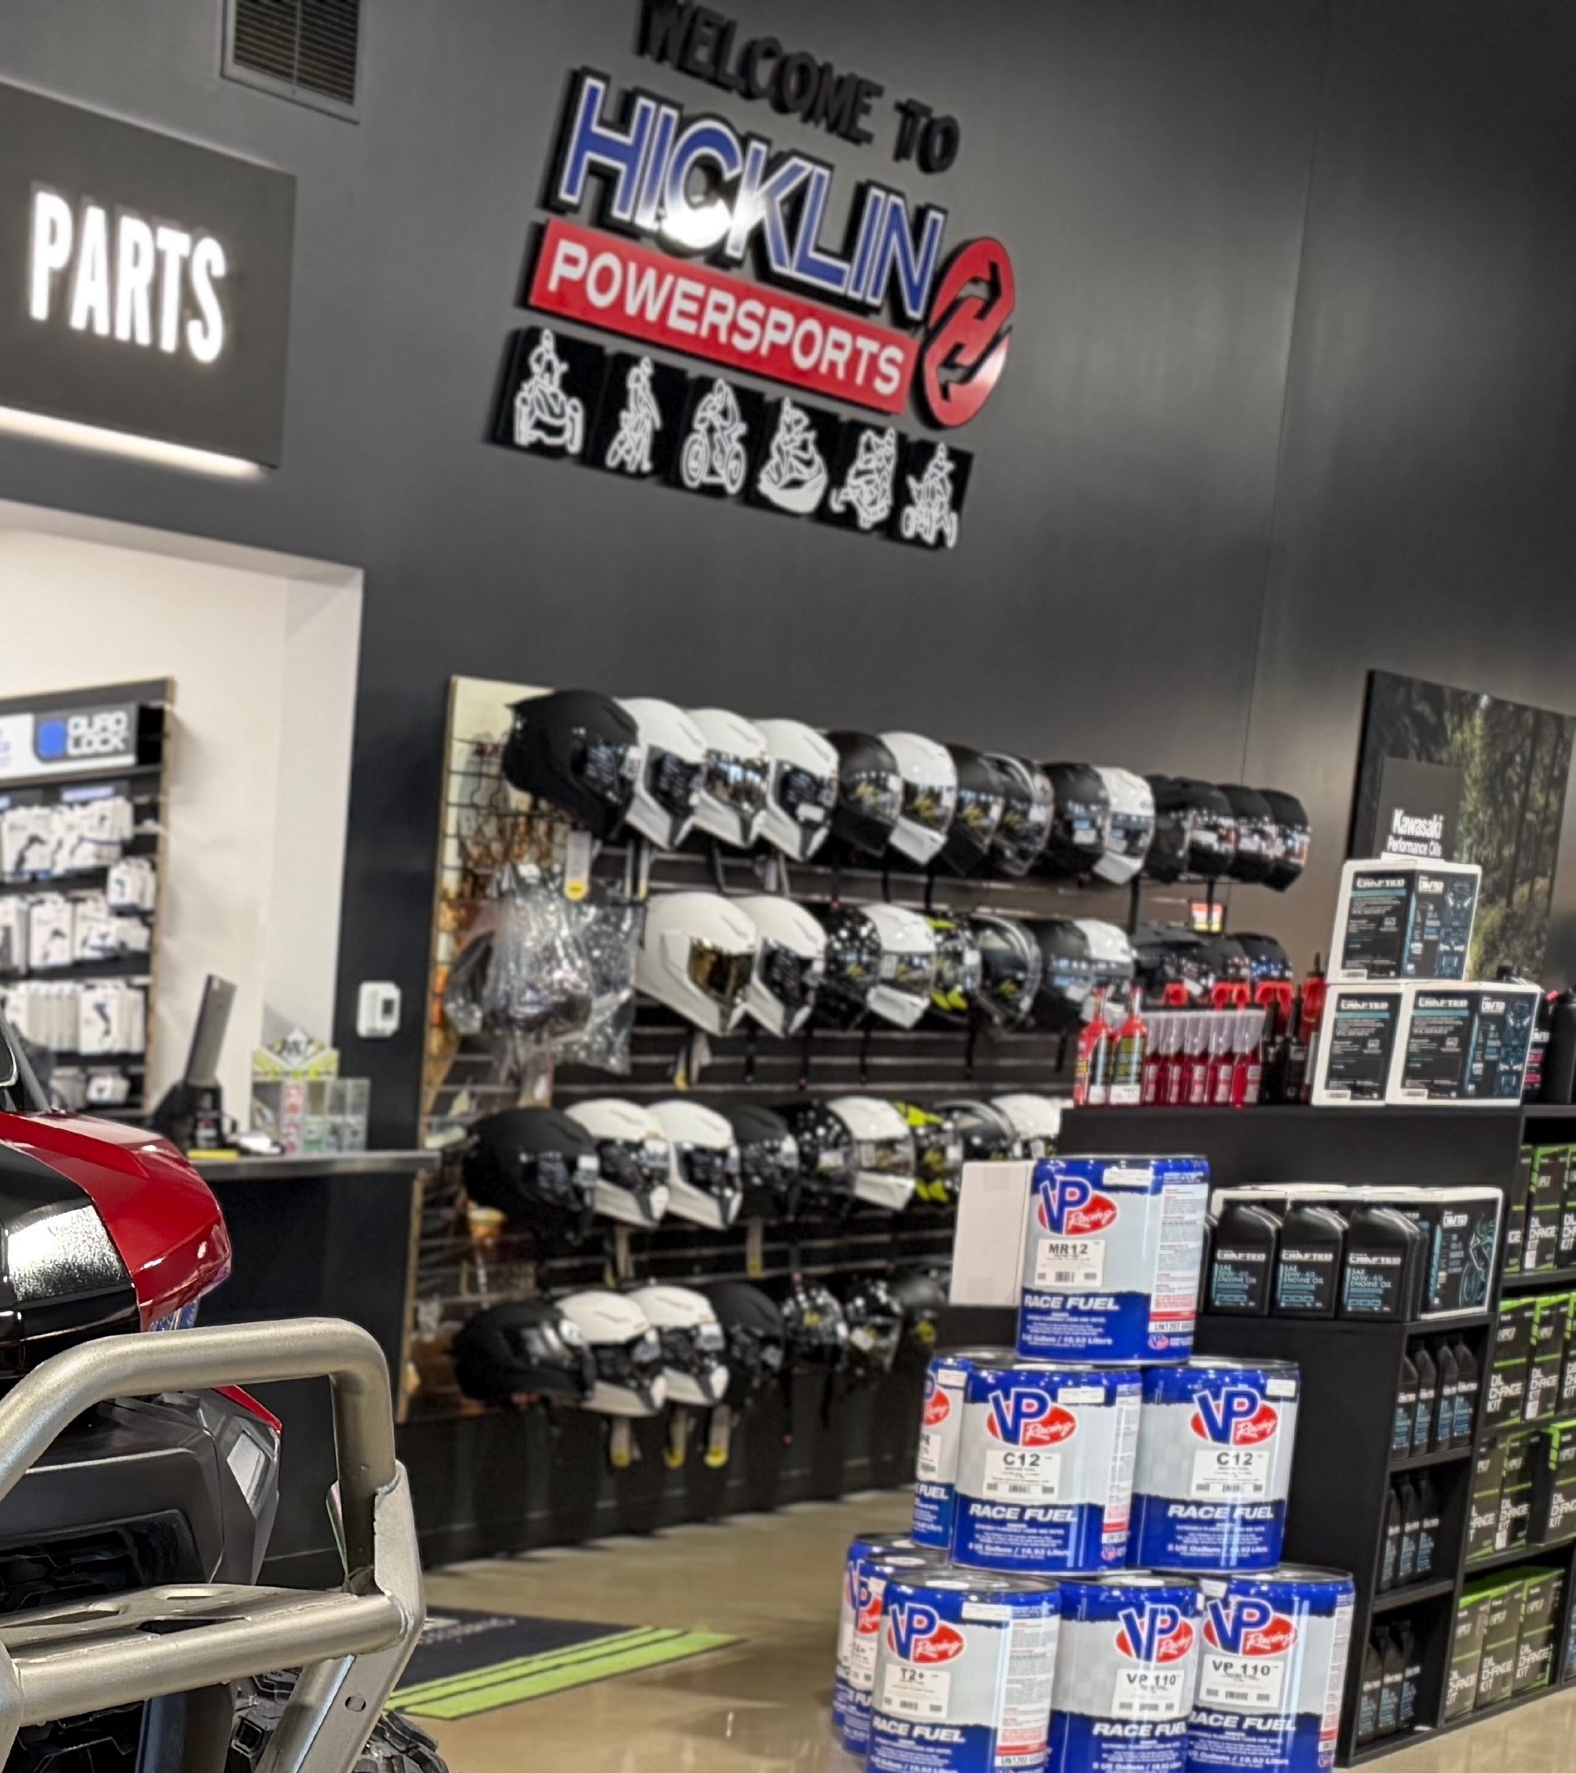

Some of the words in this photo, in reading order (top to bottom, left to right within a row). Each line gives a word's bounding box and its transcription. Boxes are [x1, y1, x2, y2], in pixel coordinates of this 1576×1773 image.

[636, 0, 884, 144] WELCOME
[893, 98, 960, 174] TO
[553, 72, 948, 322] HICKLIN
[29, 190, 228, 364] PARTS
[547, 238, 906, 397] POWERSPORTS
[66, 732, 126, 757] LOCK
[1392, 808, 1444, 839] Kawasaki
[1039, 1176, 1093, 1236] VP
[1068, 1208, 1116, 1229] Racing
[1048, 1243, 1088, 1255] MR12
[1024, 1295, 1063, 1310] RACE
[1066, 1297, 1120, 1311] FUEL
[988, 1387, 1052, 1447] VP
[1193, 1386, 1261, 1445] VP
[1025, 1419, 1077, 1440] Racing
[1235, 1419, 1278, 1440] Racing
[1003, 1452, 1040, 1467] C12
[1216, 1452, 1253, 1466] C12
[919, 1485, 948, 1499] FUEL
[969, 1504, 1021, 1520] RACE
[1024, 1507, 1078, 1522] FUEL
[1167, 1504, 1229, 1519] RACE
[1232, 1506, 1274, 1520] FUEL
[888, 1602, 940, 1663] VP
[1118, 1604, 1181, 1662] VP
[1207, 1599, 1274, 1655] VP
[915, 1639, 962, 1660] Racing
[1247, 1631, 1297, 1650] Racing
[900, 1667, 925, 1680] T2+
[1212, 1661, 1233, 1674] VP
[1240, 1662, 1270, 1676] 110
[1126, 1673, 1148, 1685] VP
[1153, 1674, 1176, 1686] 110
[873, 1717, 910, 1737] RACE
[912, 1724, 965, 1743] FUEL
[1093, 1722, 1152, 1738] RACE
[1243, 1716, 1297, 1731] FUEL
